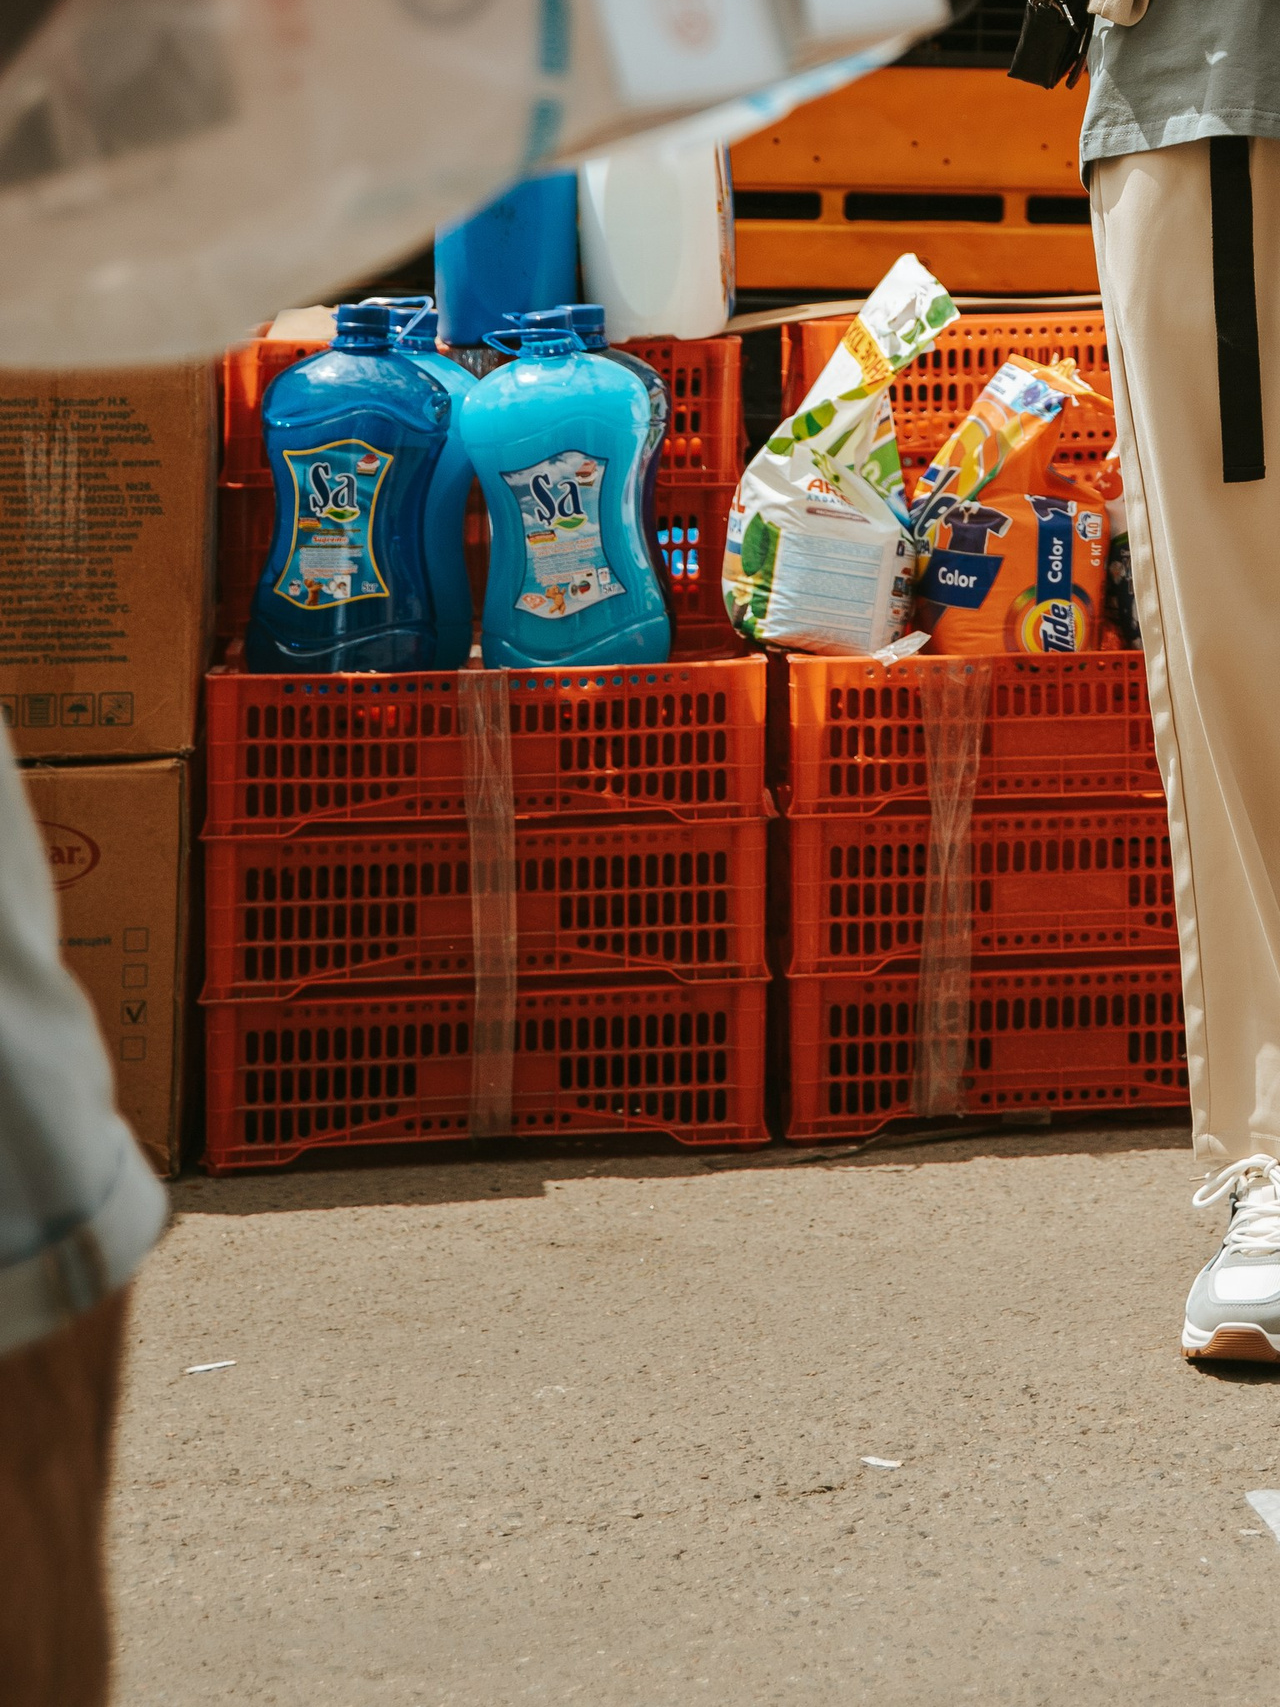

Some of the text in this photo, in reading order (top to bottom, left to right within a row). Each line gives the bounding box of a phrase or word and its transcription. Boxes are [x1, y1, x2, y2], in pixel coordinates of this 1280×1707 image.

[1087, 523, 1099, 535] 40
[1047, 537, 1064, 583] Color
[1091, 559, 1100, 567] 6
[938, 566, 978, 589] Color
[1041, 603, 1070, 652] Tide
